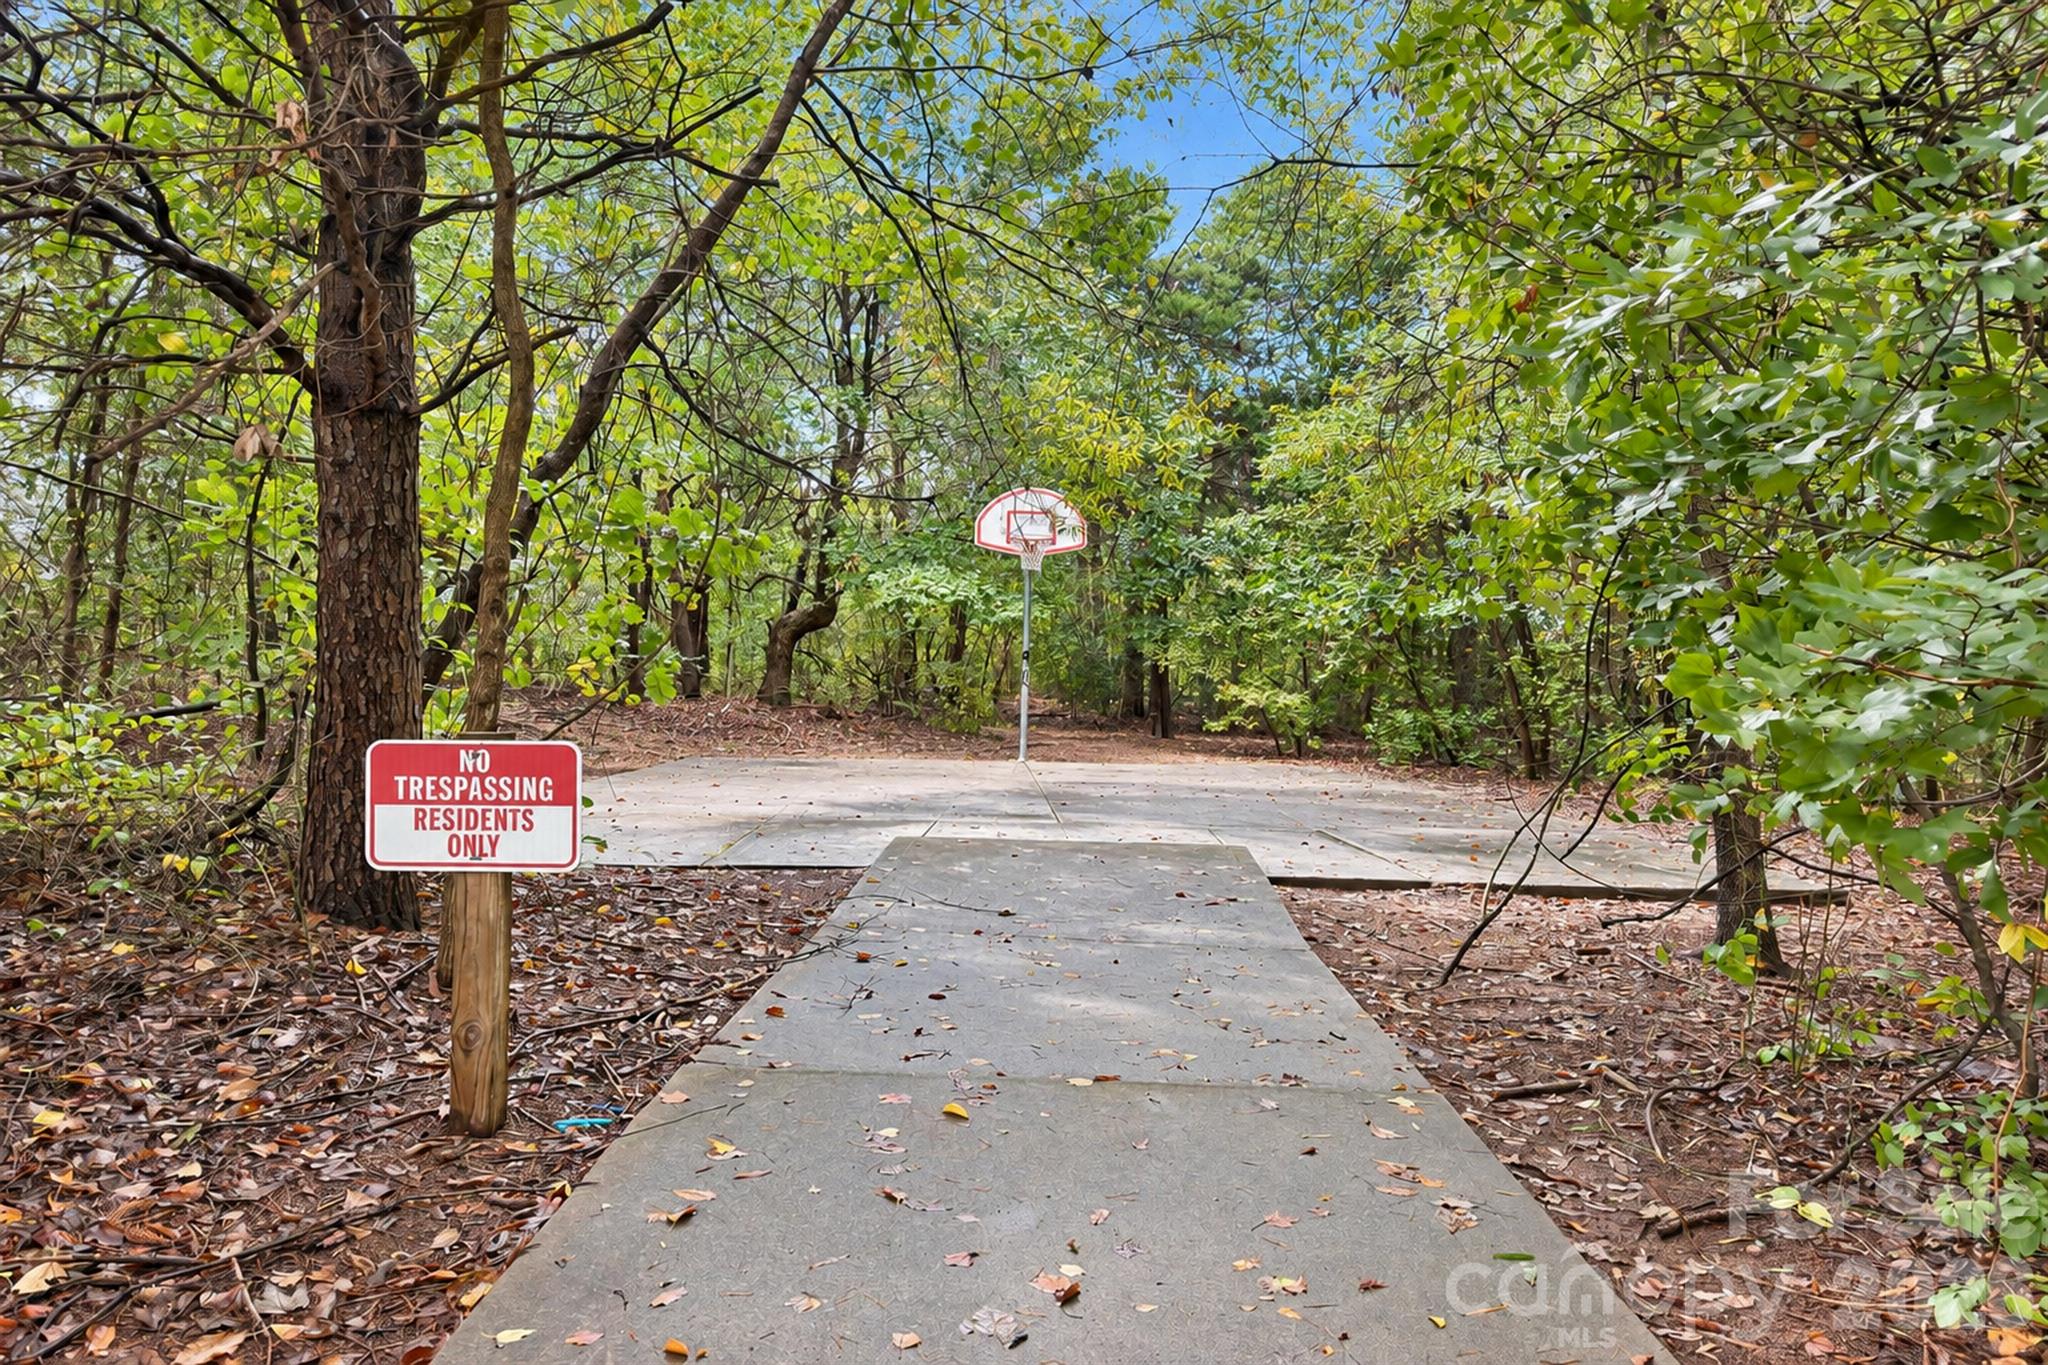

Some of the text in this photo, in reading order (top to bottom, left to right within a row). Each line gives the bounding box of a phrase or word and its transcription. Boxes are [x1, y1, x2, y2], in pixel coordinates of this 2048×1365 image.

[459, 749, 490, 773] NO
[394, 776, 553, 801] TRESPASSING
[414, 808, 534, 832] RESIDENTS
[447, 833, 500, 858] ONLY
